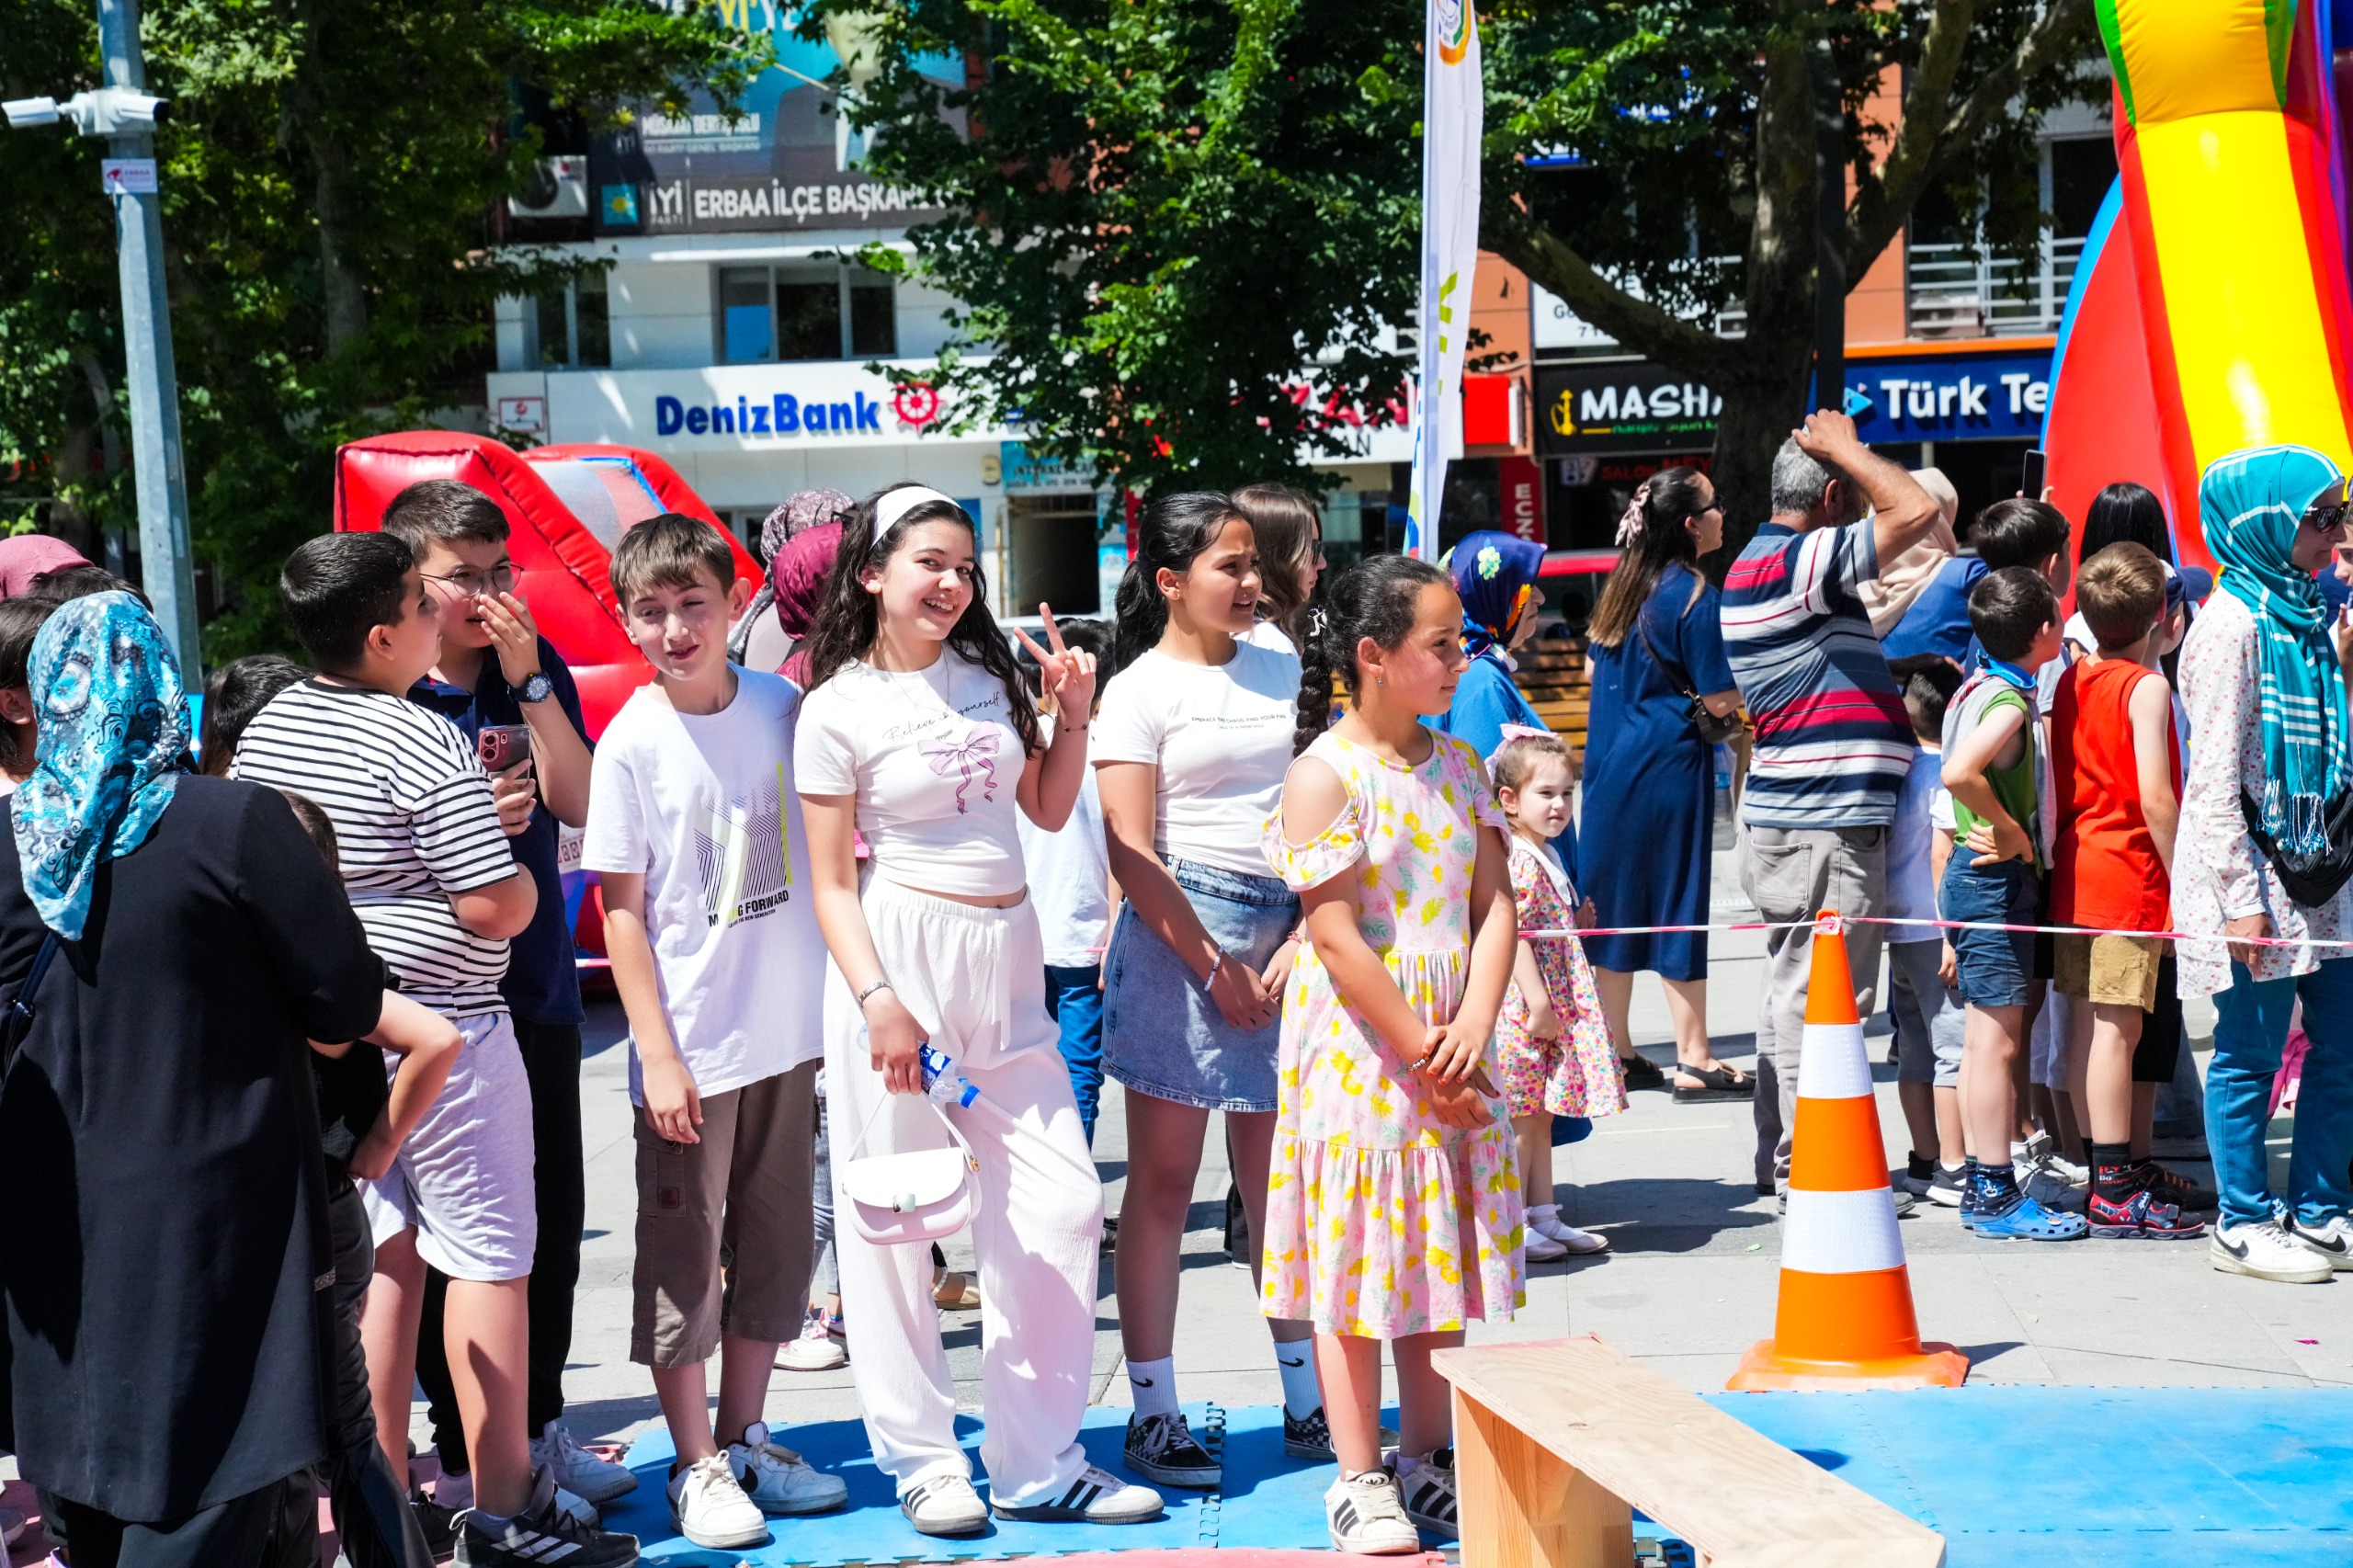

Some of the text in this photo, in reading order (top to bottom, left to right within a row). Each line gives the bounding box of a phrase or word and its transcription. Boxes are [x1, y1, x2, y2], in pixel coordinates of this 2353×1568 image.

[694, 187, 770, 219] ERBAA
[771, 177, 824, 224] İLÇE
[656, 392, 880, 435] DenizBank
[1880, 372, 2049, 419] Türk Te
[882, 718, 936, 743] Believe
[957, 691, 1000, 723] yourself
[745, 890, 790, 914] FORWARD
